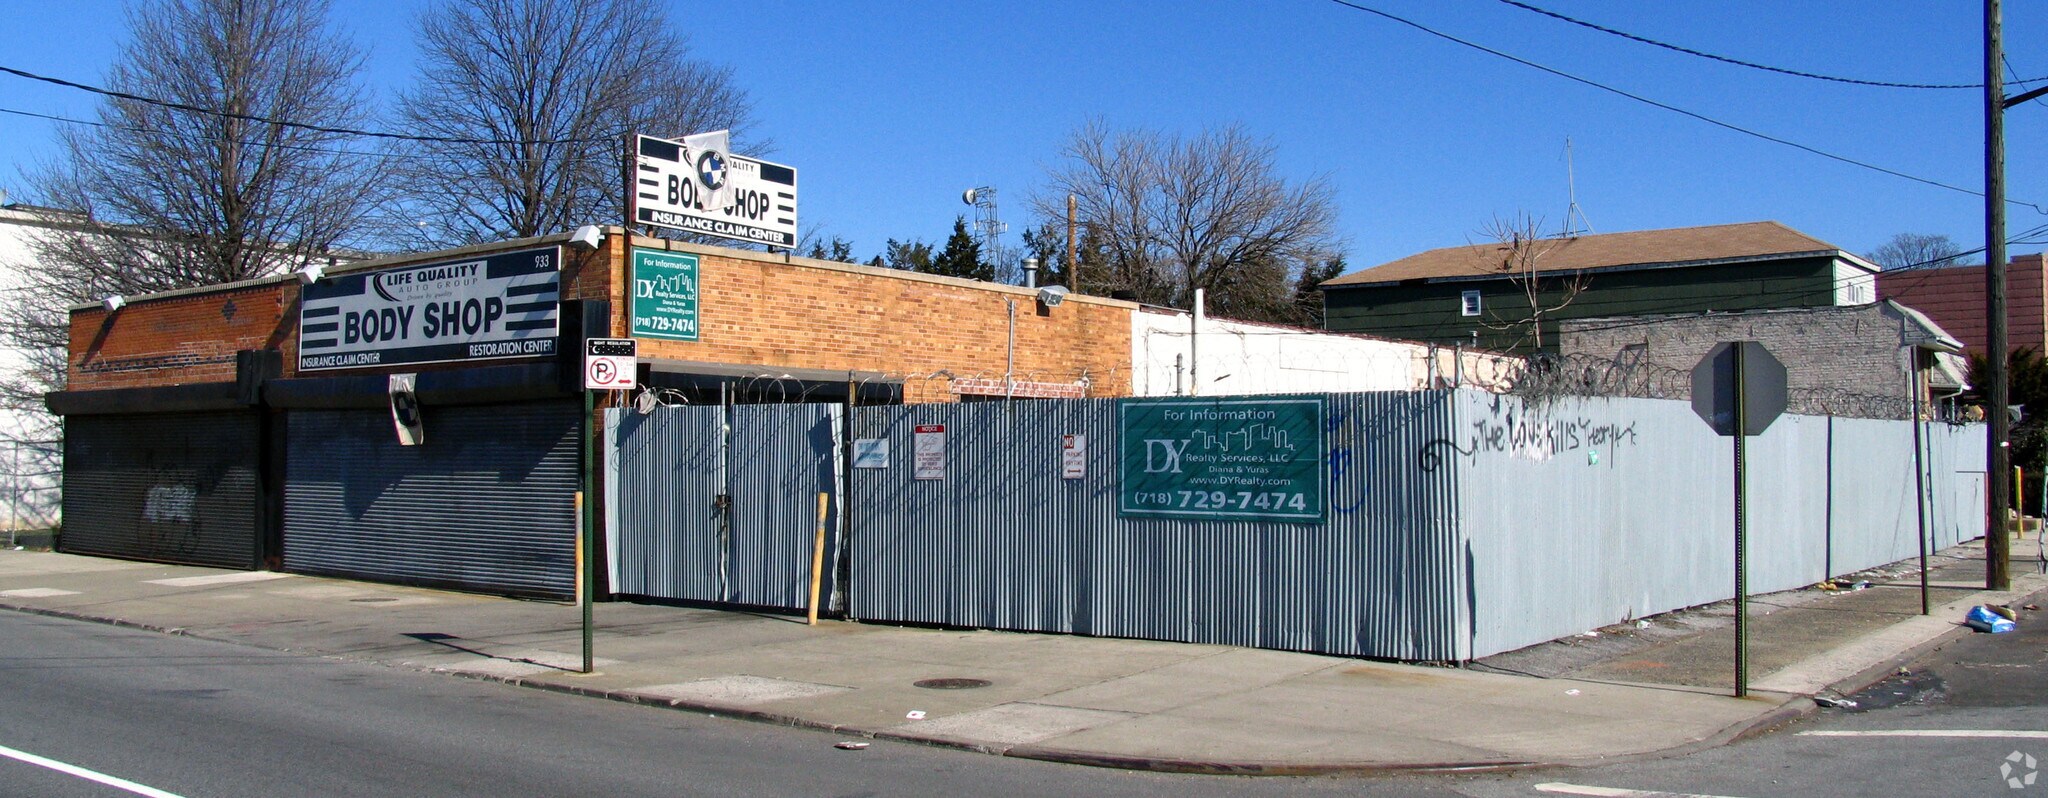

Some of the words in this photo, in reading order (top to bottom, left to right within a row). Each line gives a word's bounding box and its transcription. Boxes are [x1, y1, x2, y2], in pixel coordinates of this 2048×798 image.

[652, 211, 713, 232] INSURANCE
[714, 223, 748, 238] CLAIM
[749, 229, 785, 243] CENTER
[534, 254, 550, 269] 933
[643, 257, 654, 268] For
[655, 259, 692, 271] Information
[387, 272, 412, 286] LIFE
[417, 263, 479, 282] QUALITY
[399, 284, 429, 293] AUTO
[437, 278, 478, 289] GROUP
[636, 279, 658, 299] DY
[345, 305, 415, 344] BODY
[423, 297, 503, 339] SHOP
[635, 316, 651, 328] (718)
[652, 316, 694, 333] 729-7474
[469, 342, 522, 357] RESTORATION
[523, 340, 553, 353] CENTER
[302, 354, 336, 368] INSURANCE
[336, 353, 357, 366] CLAIM
[357, 352, 381, 365] CENTER
[1164, 409, 1185, 421] For
[1190, 408, 1276, 420] Information
[1063, 436, 1074, 448] NO
[1144, 439, 1191, 473] DY
[1186, 453, 1217, 463] Realty
[1220, 453, 1266, 464] Services,
[1269, 453, 1289, 463] LLC
[1209, 465, 1234, 473] Diana
[1245, 465, 1269, 474] Yuras
[1190, 475, 1291, 487] www.DYRealty.com
[1134, 491, 1172, 506] (718)
[1177, 490, 1307, 511] 729-7474
